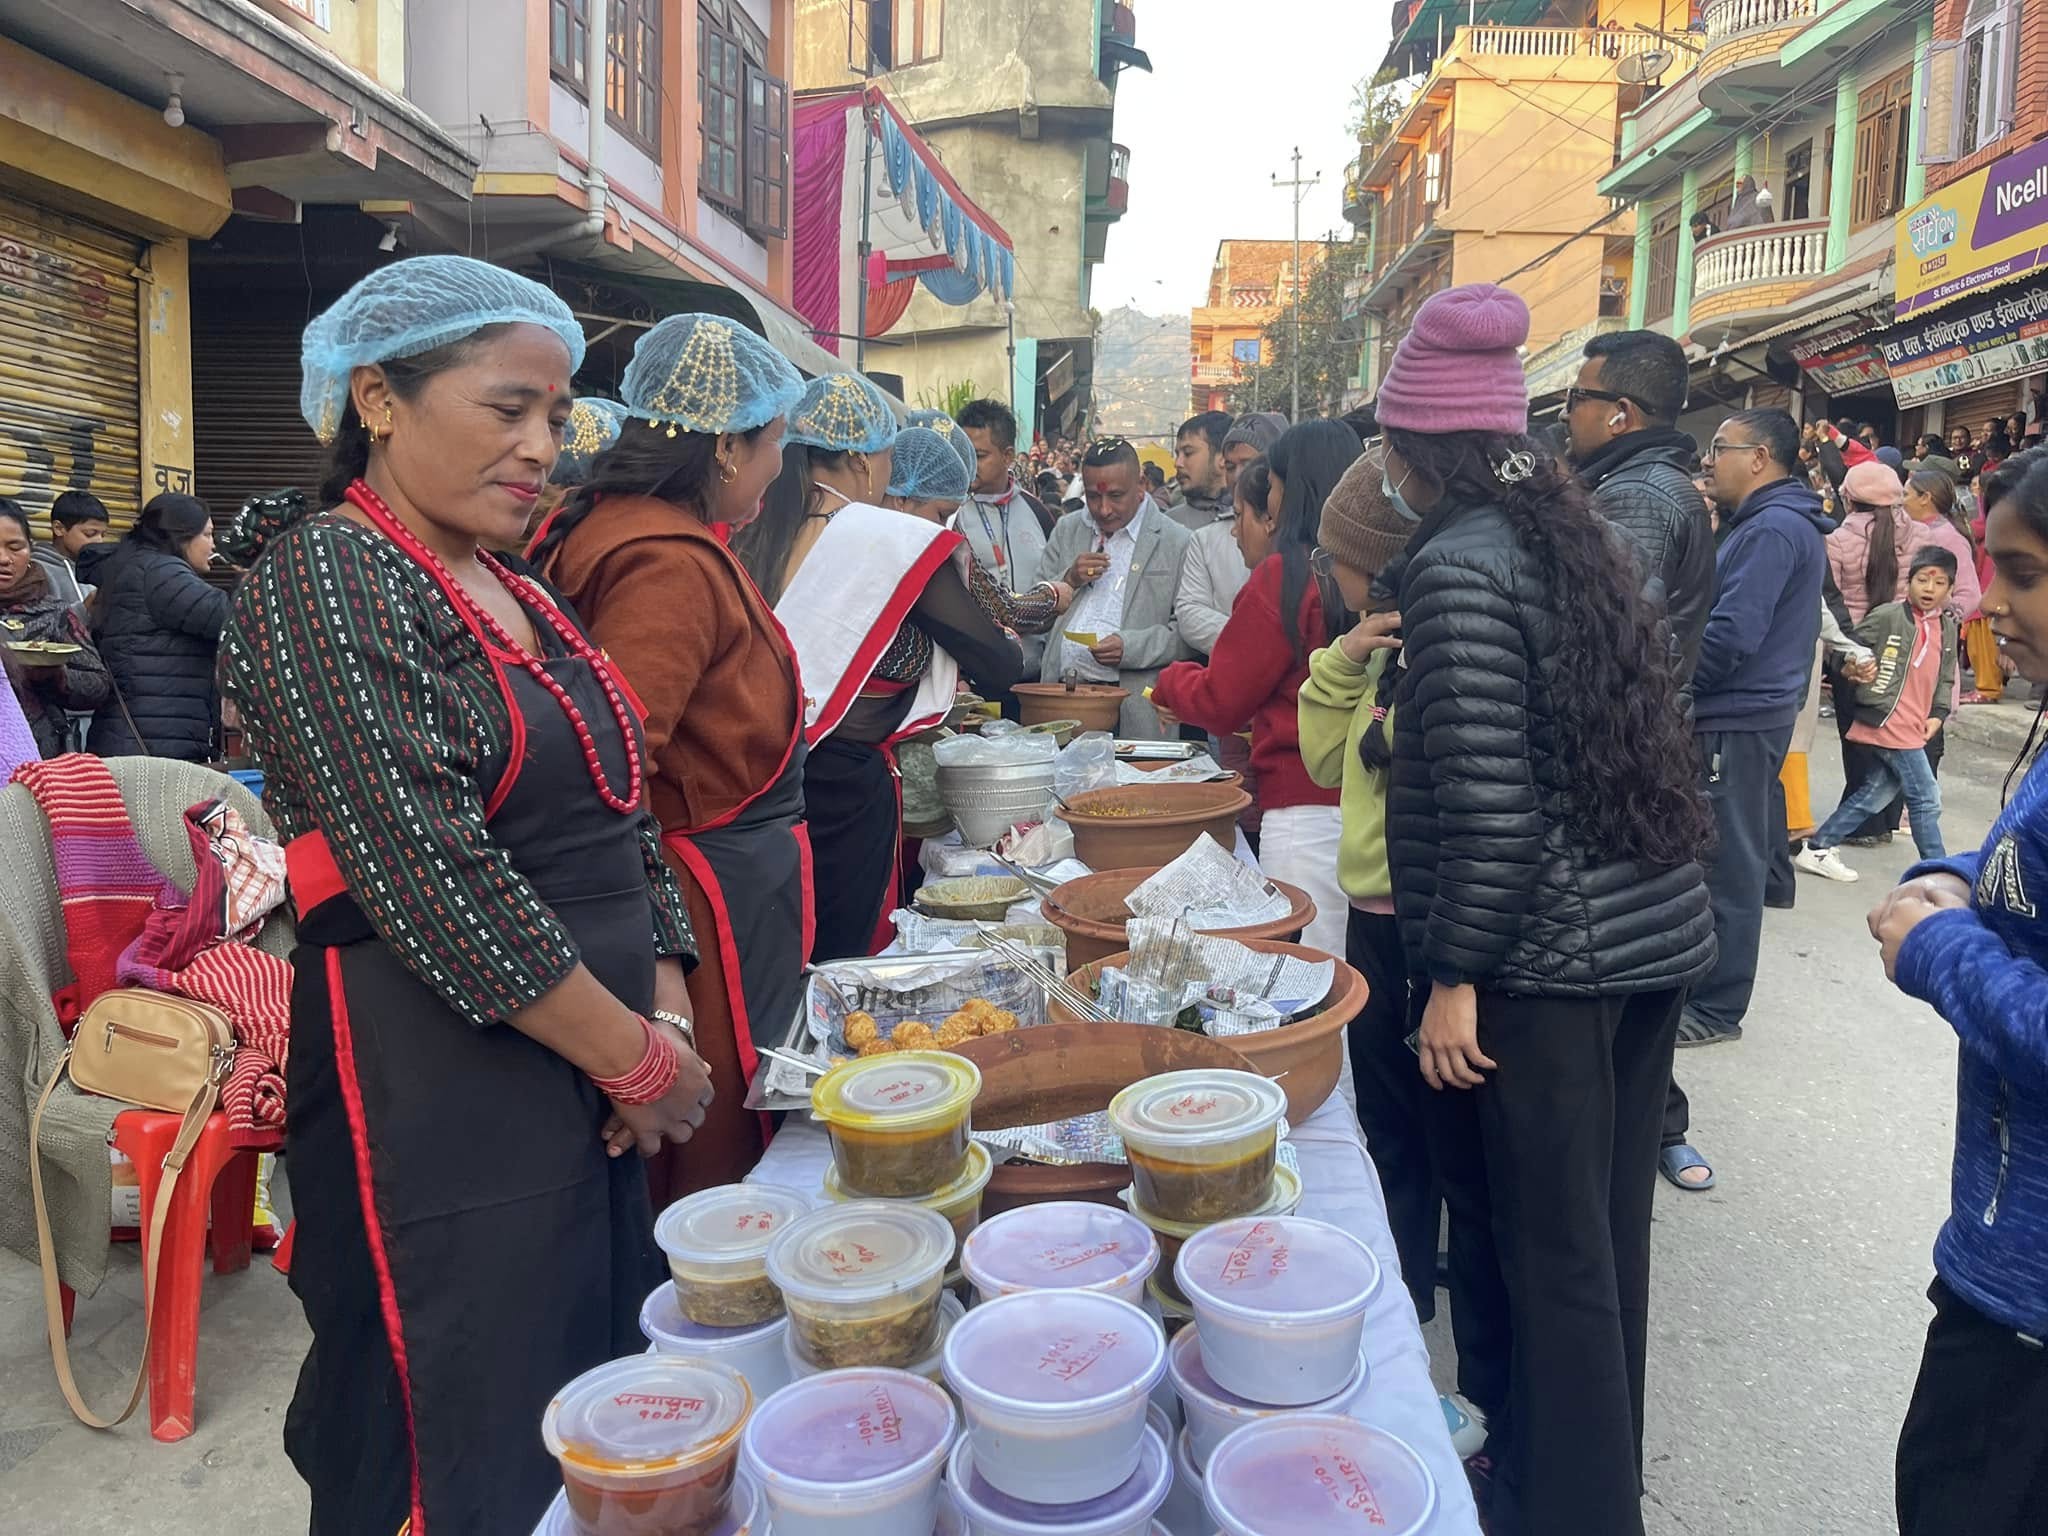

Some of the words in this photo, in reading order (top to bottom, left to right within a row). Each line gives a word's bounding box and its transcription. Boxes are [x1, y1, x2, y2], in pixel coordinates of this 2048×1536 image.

[1996, 165, 2047, 216] Ncell
[1884, 342, 1903, 361] एस.
[1903, 335, 1924, 354] एल.
[1970, 310, 1995, 333] एण्ड
